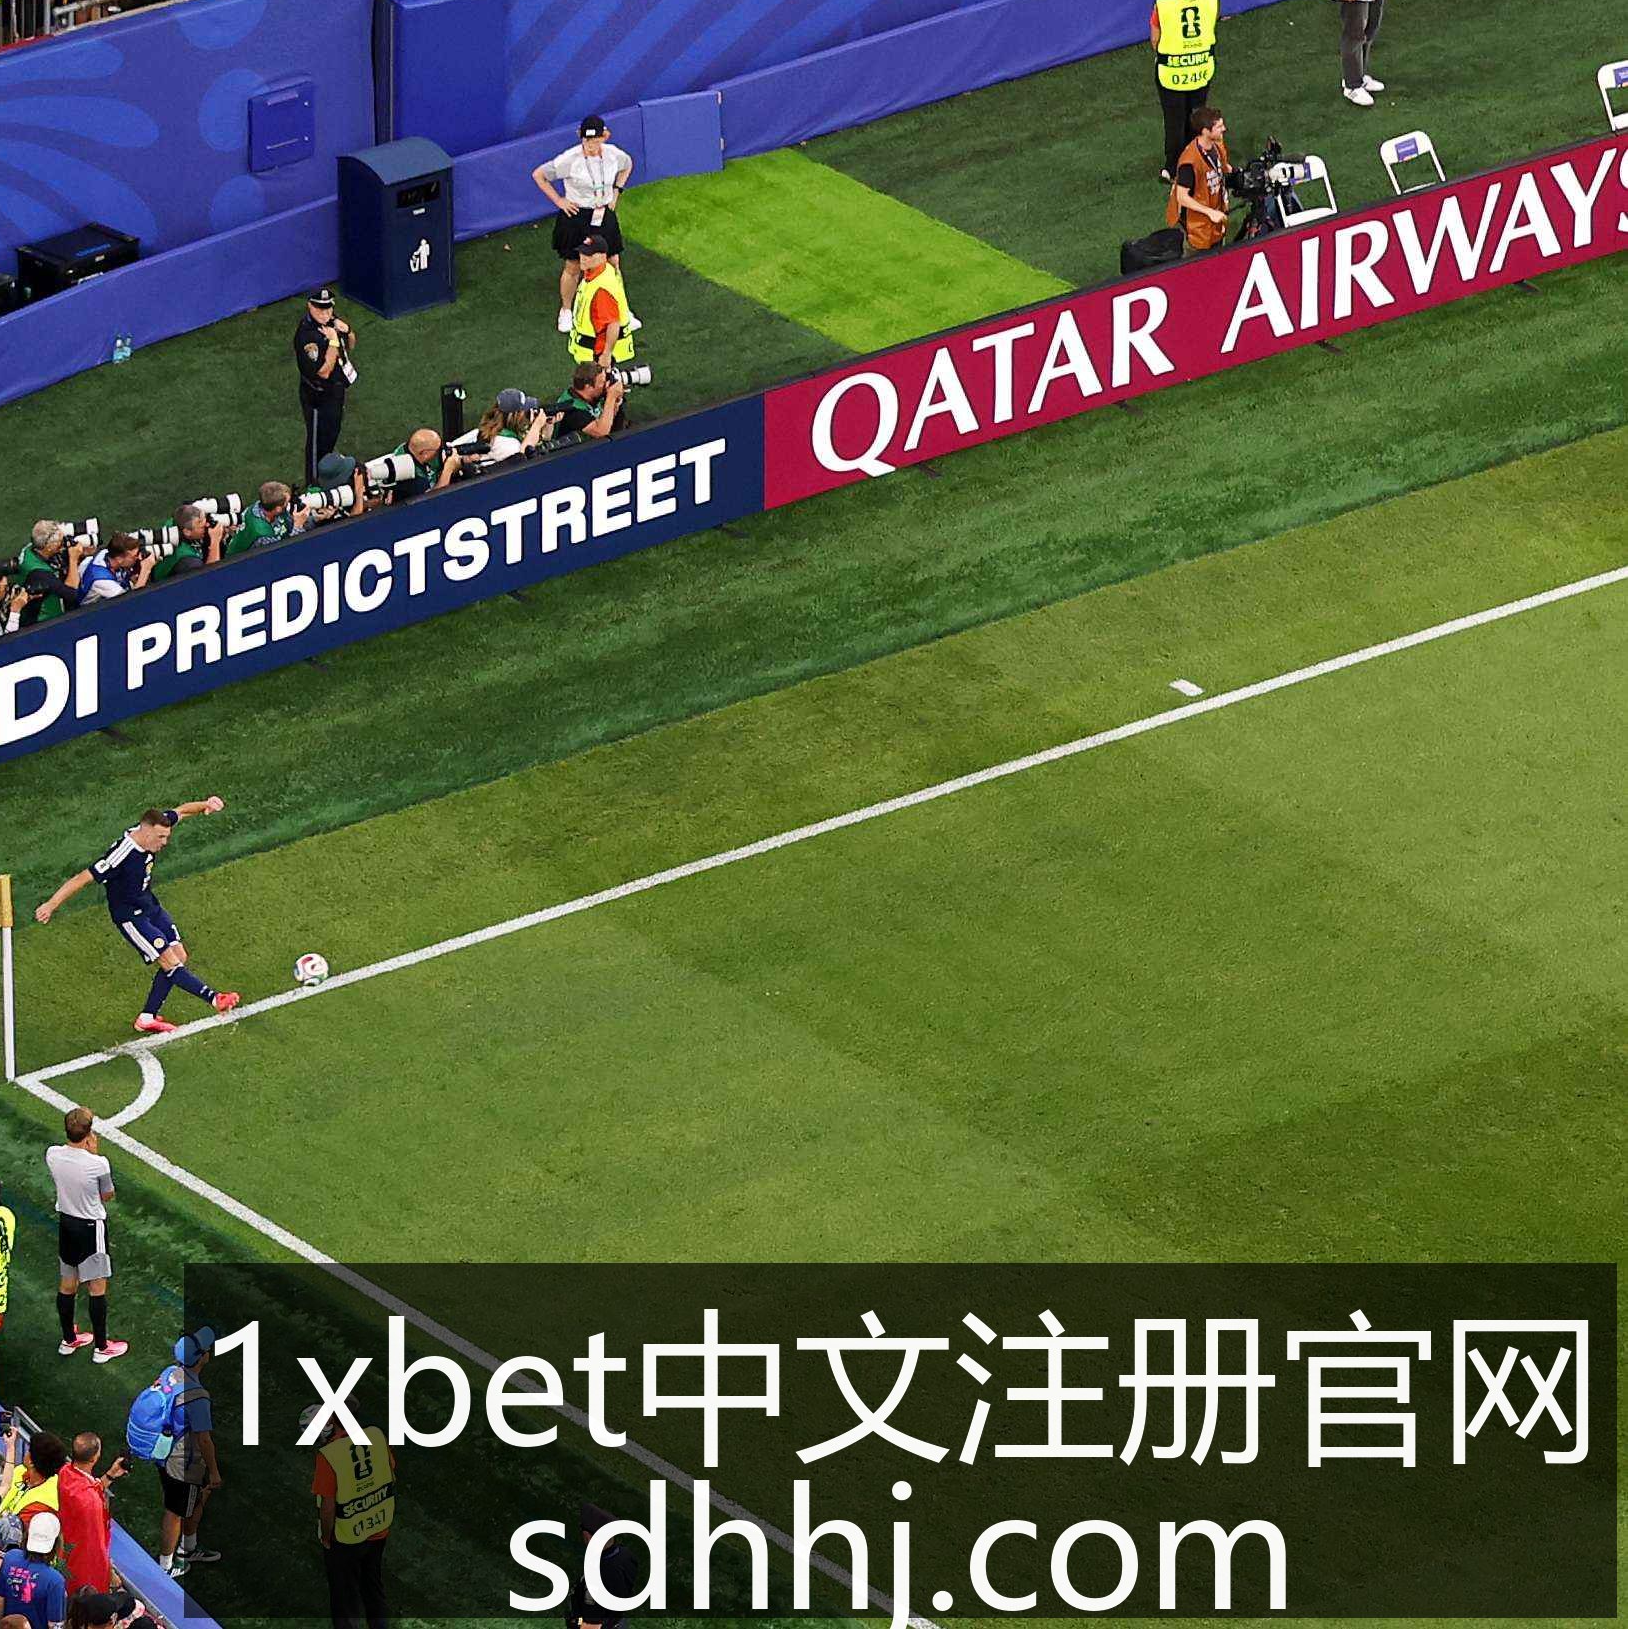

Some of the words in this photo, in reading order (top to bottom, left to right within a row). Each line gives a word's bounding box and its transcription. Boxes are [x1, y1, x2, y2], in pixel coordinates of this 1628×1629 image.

[812, 286, 1175, 477] QATAR
[1220, 147, 1628, 353] AIRWAY
[127, 438, 726, 690] PREDICTSTREET
[343, 1485, 389, 1518] SECURITY
